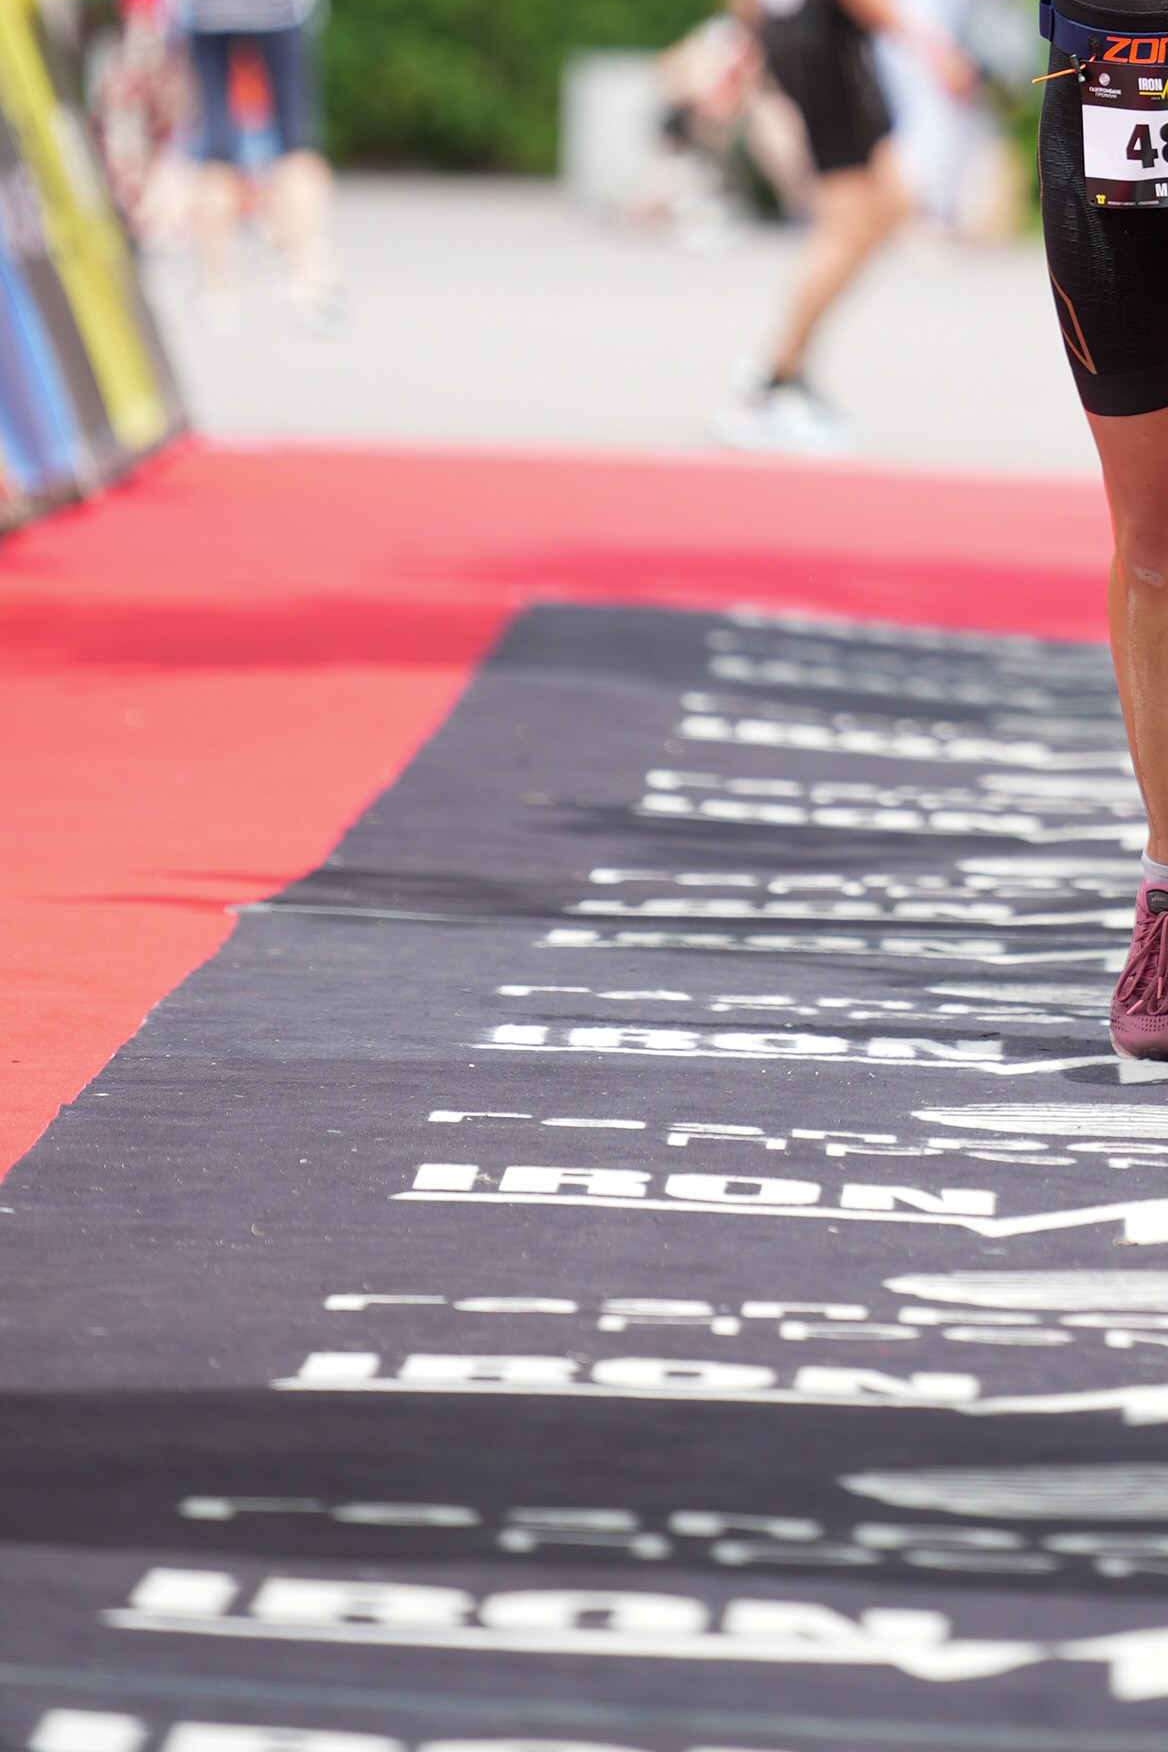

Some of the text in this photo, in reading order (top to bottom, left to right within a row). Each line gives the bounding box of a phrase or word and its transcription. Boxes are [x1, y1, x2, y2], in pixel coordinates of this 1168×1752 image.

[1138, 77, 1163, 91] IRON
[484, 1024, 1003, 1061] IRON
[411, 1163, 998, 1216] IRON
[297, 1352, 980, 1403] IRON
[128, 1568, 952, 1647] IRON
